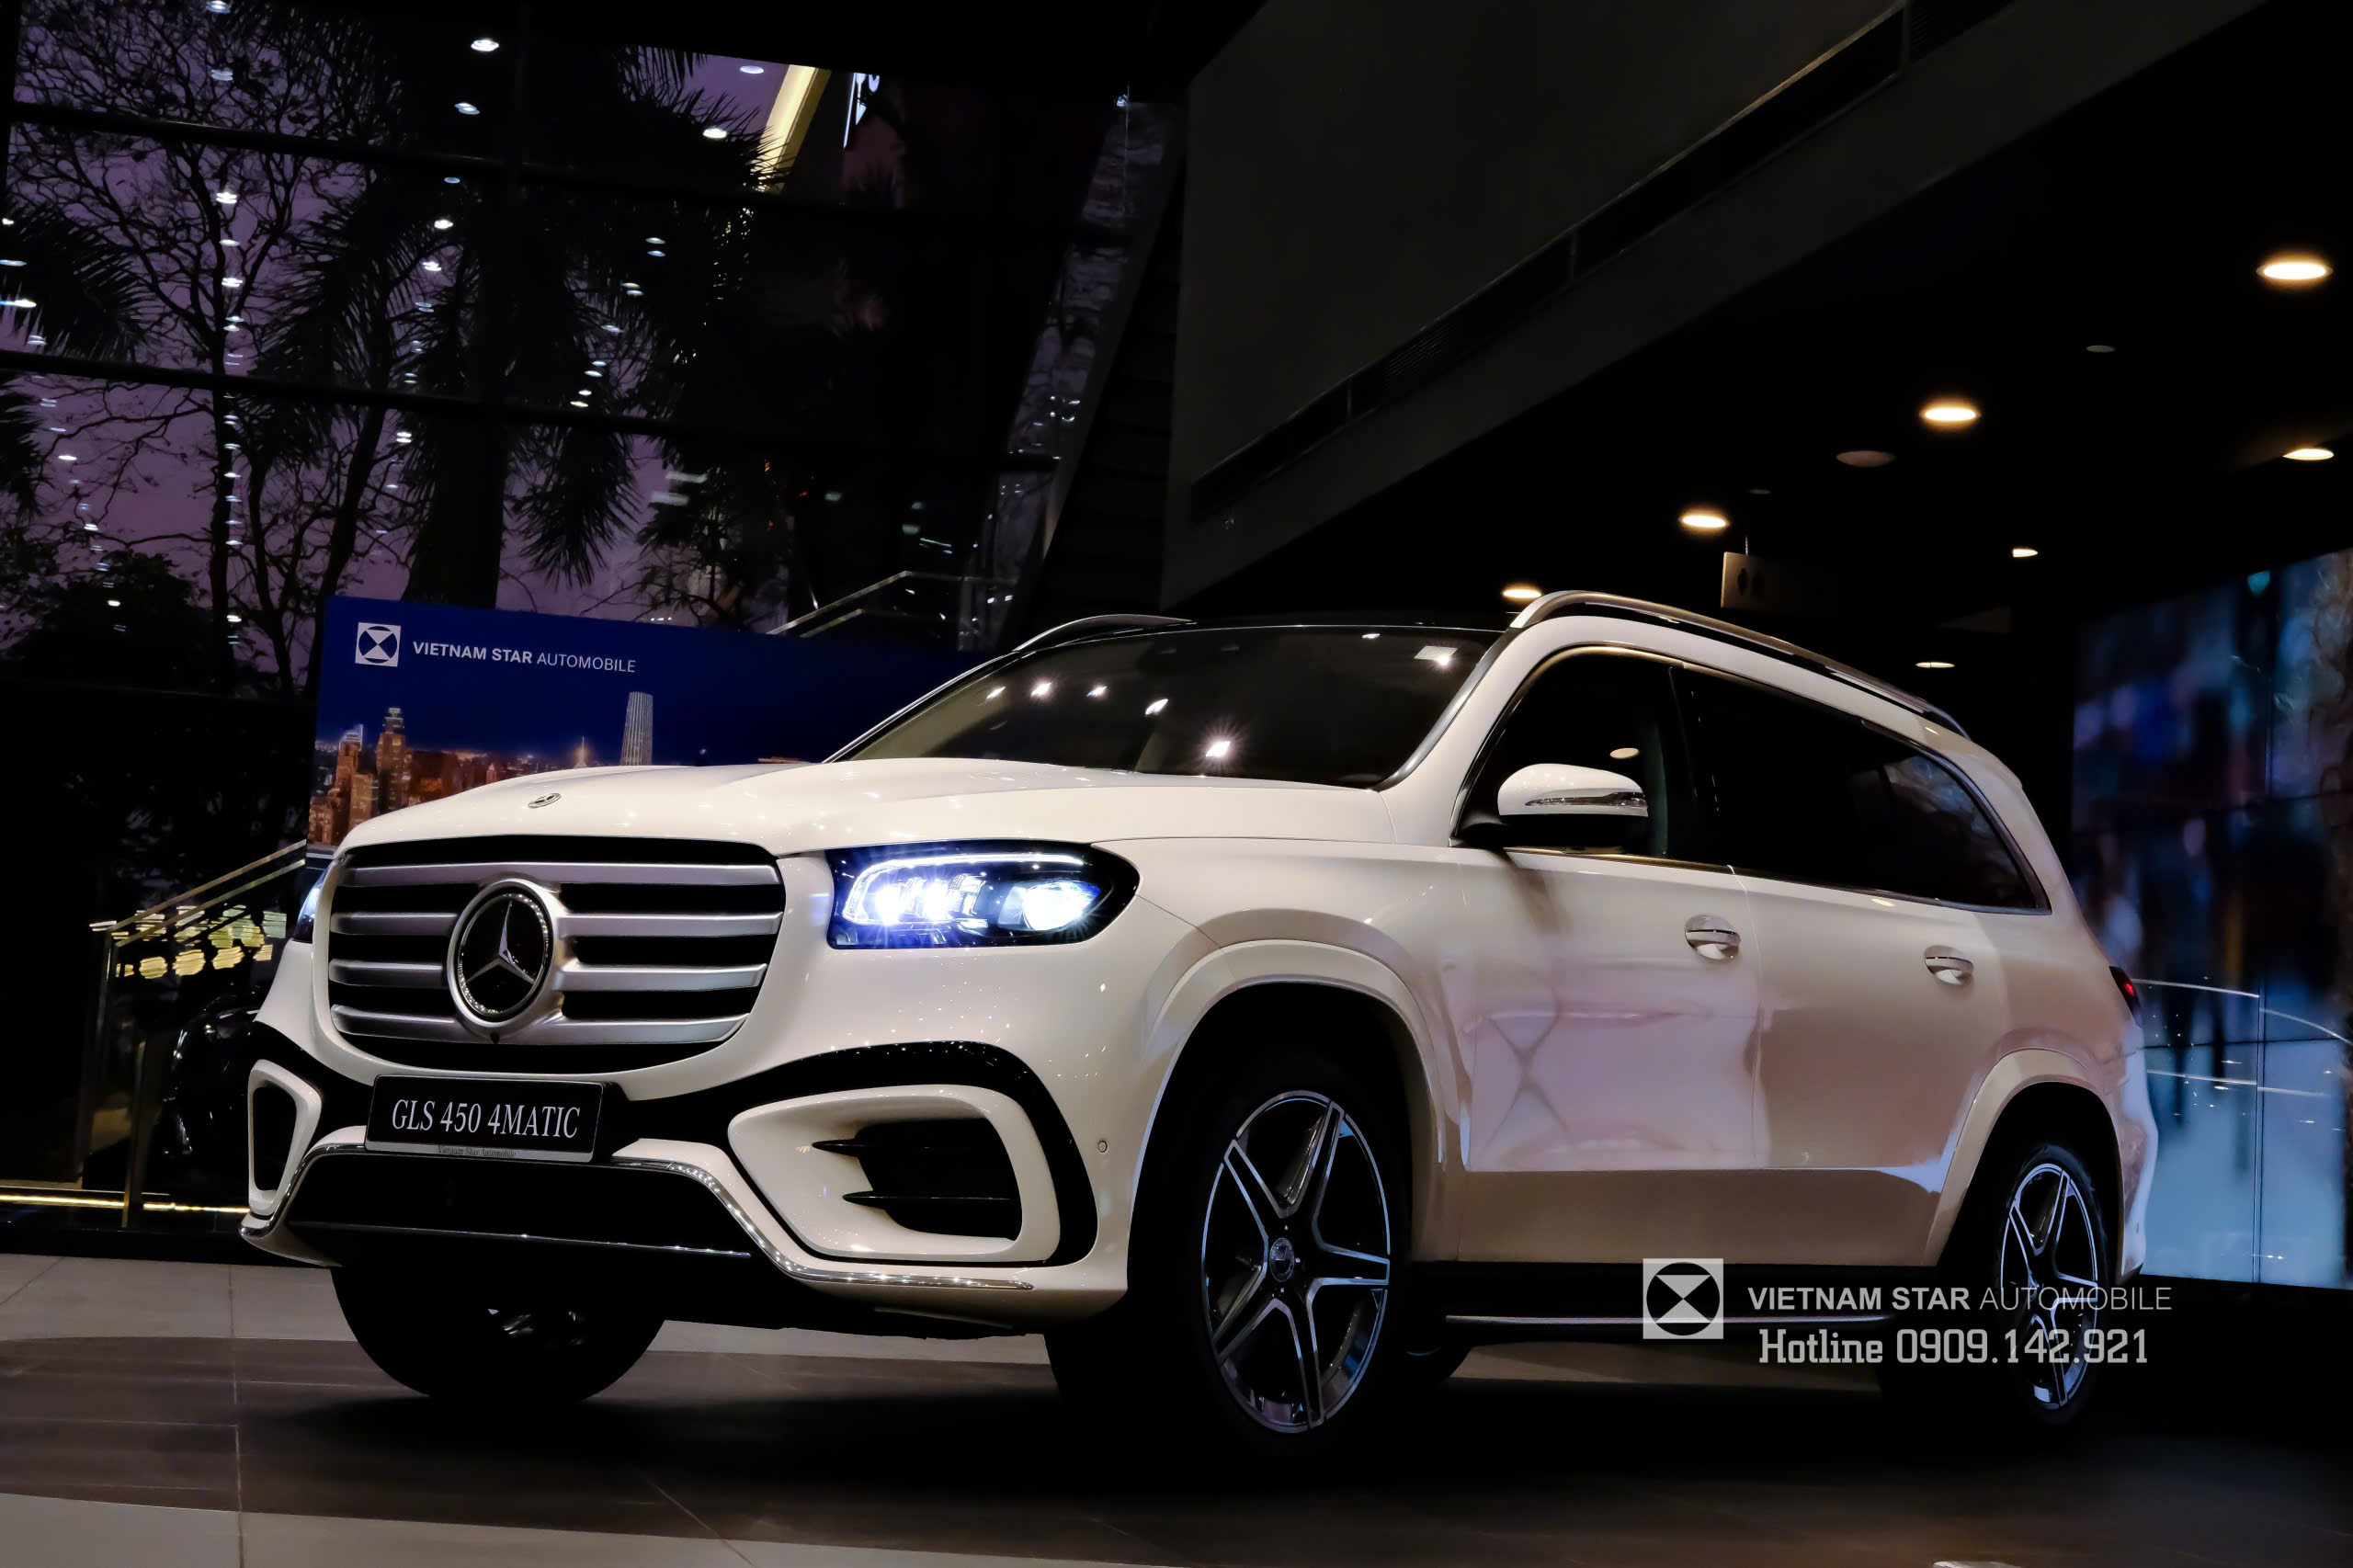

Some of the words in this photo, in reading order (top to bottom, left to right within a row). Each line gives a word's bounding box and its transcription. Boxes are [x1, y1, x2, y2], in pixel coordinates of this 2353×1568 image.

[413, 642, 487, 661] VIETNAM
[491, 649, 533, 665] STAR
[536, 652, 637, 673] AUTOMOBILE
[392, 1099, 435, 1131] GLS
[439, 1102, 483, 1133] 450
[487, 1104, 581, 1139] 4MATIC
